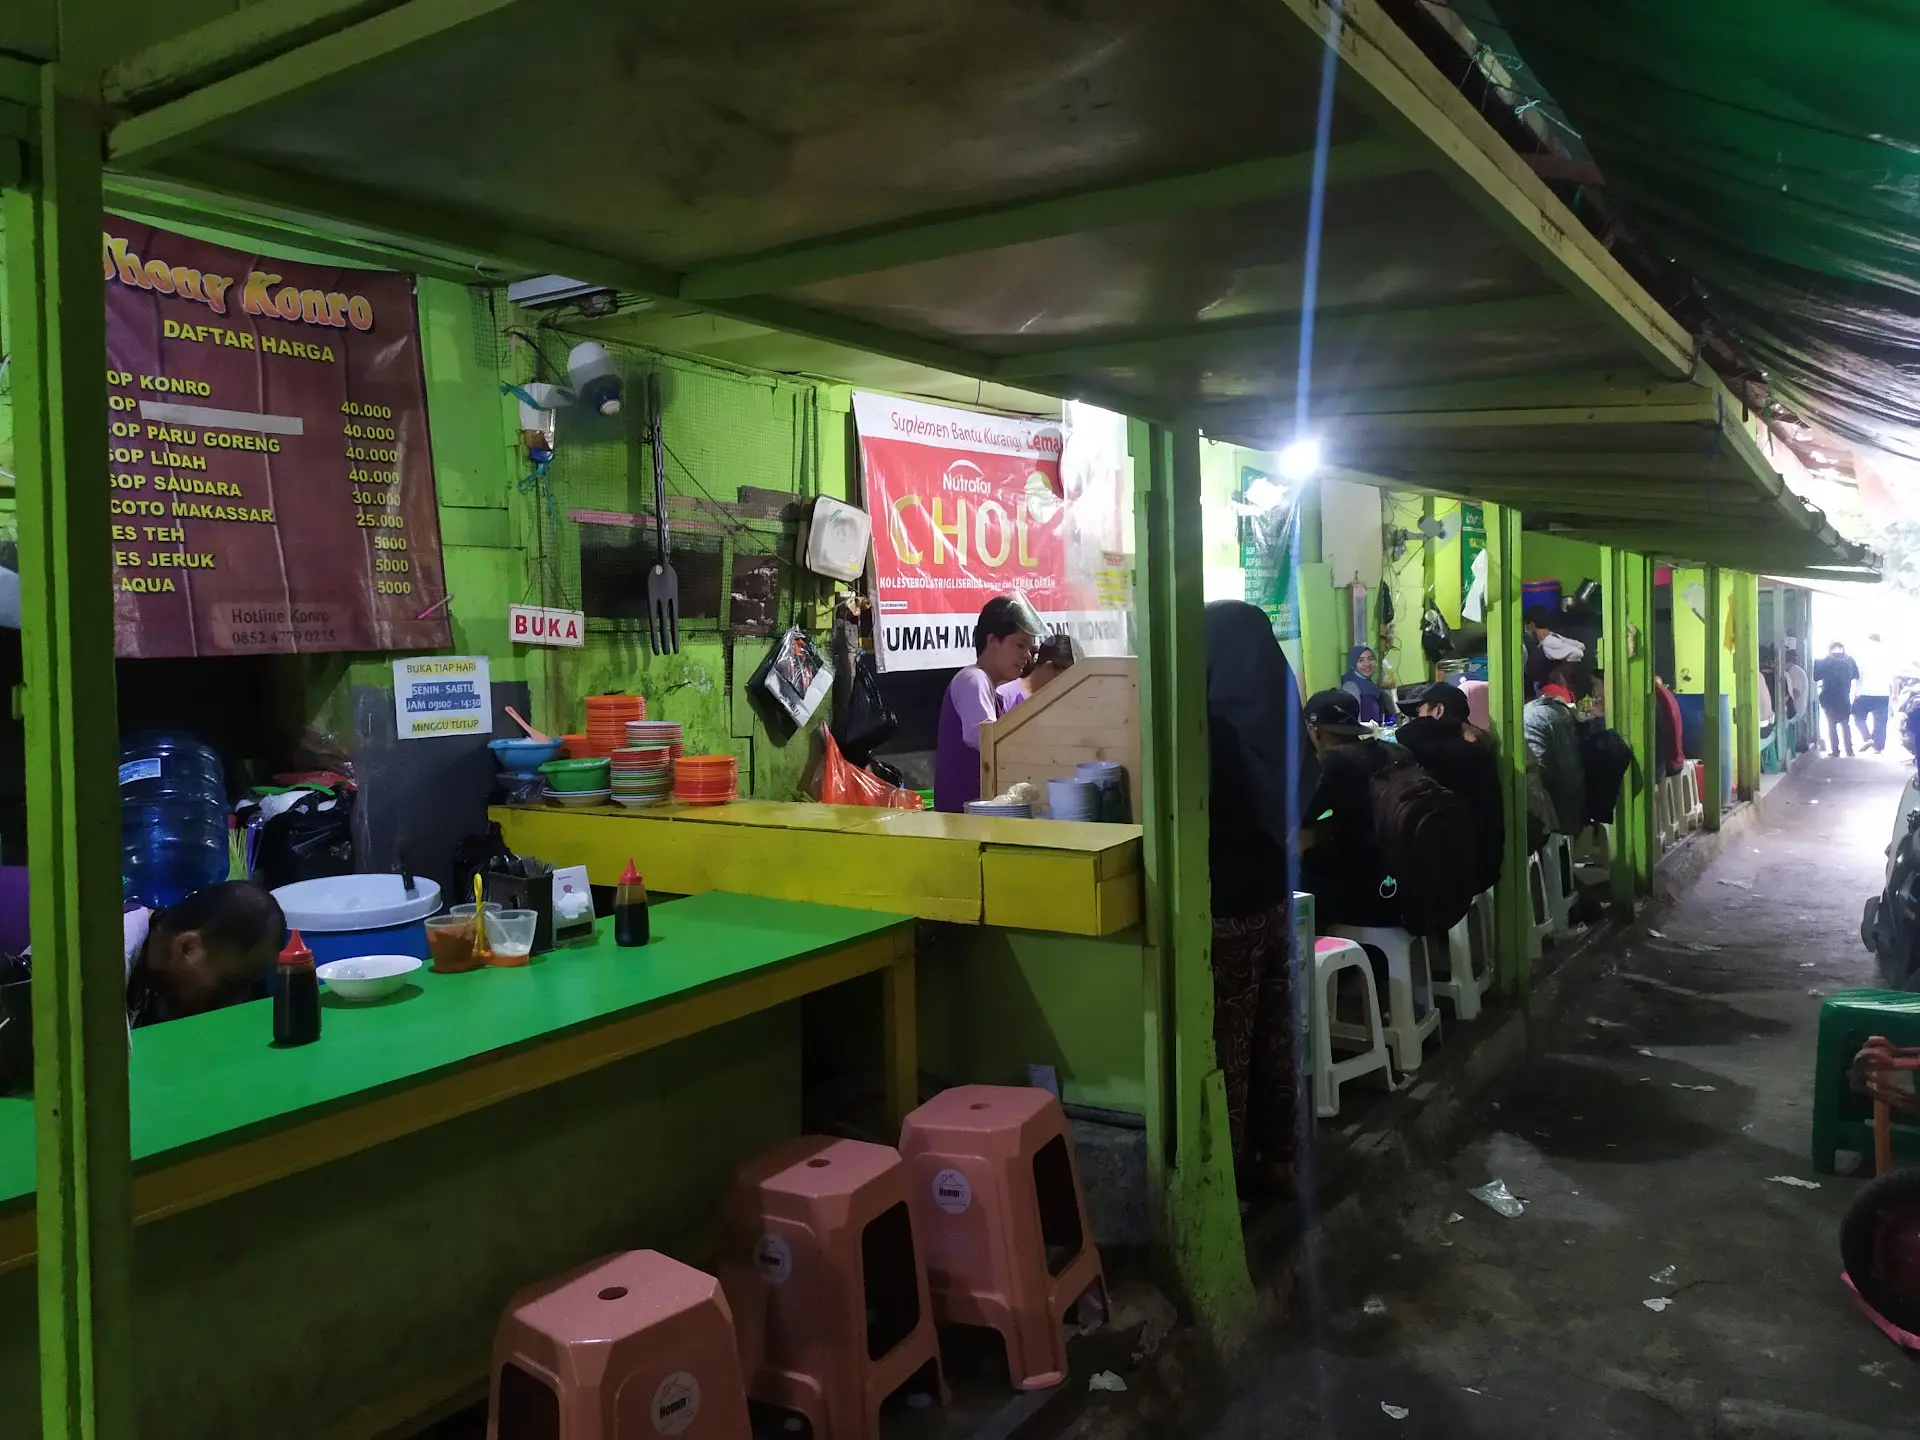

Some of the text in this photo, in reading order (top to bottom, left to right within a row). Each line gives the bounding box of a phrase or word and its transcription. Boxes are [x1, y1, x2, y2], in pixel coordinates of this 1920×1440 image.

[243, 271, 374, 331] Konro
[163, 319, 335, 363] DAFTAR HARGA
[139, 374, 212, 397] KONRO
[340, 400, 392, 419] 40.000
[109, 421, 281, 453] OP PARU GORENG
[343, 423, 396, 441] 40.000
[890, 411, 950, 439] Suplemen
[951, 421, 983, 444] Bantu
[983, 427, 1022, 453] Kurangi
[150, 450, 207, 470] LIDAH
[346, 446, 398, 463] 40.000
[349, 468, 400, 485] 40.000
[153, 476, 243, 497] SAUDARA
[352, 490, 401, 507] 30.000
[111, 499, 275, 522] COTO MAKASSAR
[355, 513, 404, 528] 25.000
[111, 524, 185, 542] ES TEH
[889, 494, 1039, 568] CHOL
[374, 535, 408, 550] 5000
[115, 551, 216, 568] ES JERUK
[375, 558, 409, 573] 5000
[121, 577, 177, 593] AQUA
[377, 581, 412, 594] 5000
[879, 576, 930, 590] KOLESTEROL
[231, 608, 330, 624] Hotline Konro
[515, 614, 579, 640] BUKA
[883, 625, 950, 652] UMAH
[406, 662, 477, 674] BUKA TIAP HARI
[412, 685, 440, 696] SENIN
[445, 683, 475, 694] SABTU
[406, 700, 427, 711] JAM
[428, 700, 452, 711] 09:00
[460, 698, 481, 709] 14:30
[412, 719, 480, 733] MINGGU TUTUP
